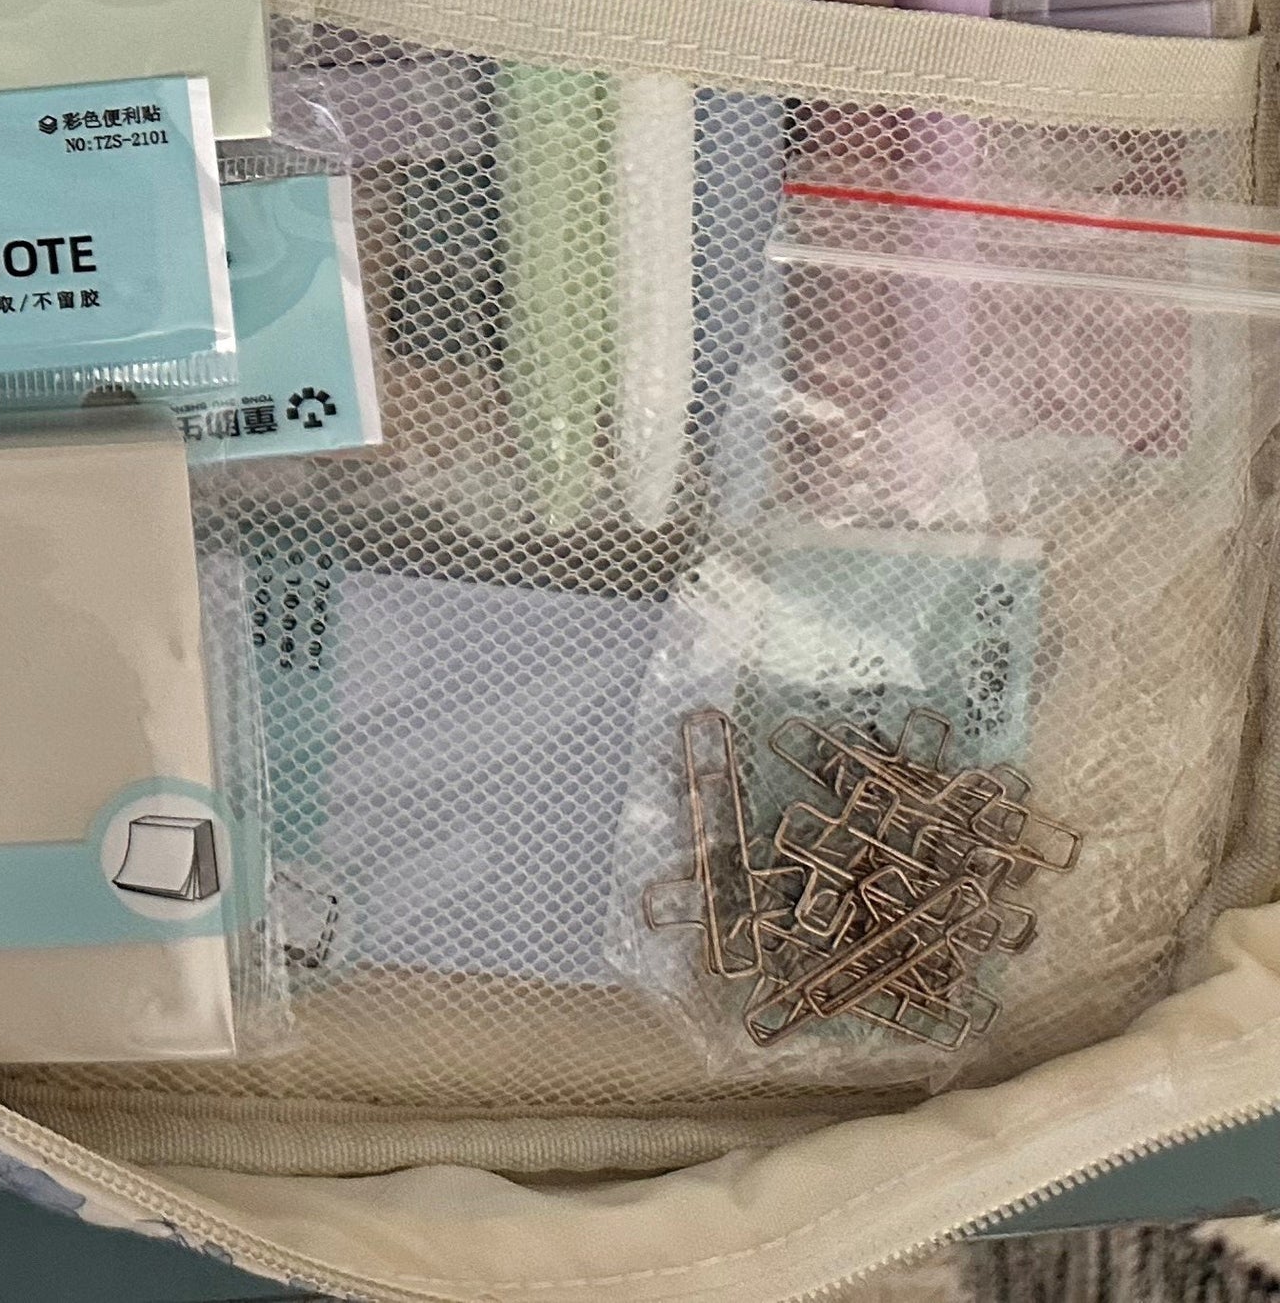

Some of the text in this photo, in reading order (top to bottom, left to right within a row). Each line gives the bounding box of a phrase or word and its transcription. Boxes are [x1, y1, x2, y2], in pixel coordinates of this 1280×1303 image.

[62, 104, 162, 131] 彩色便利贴
